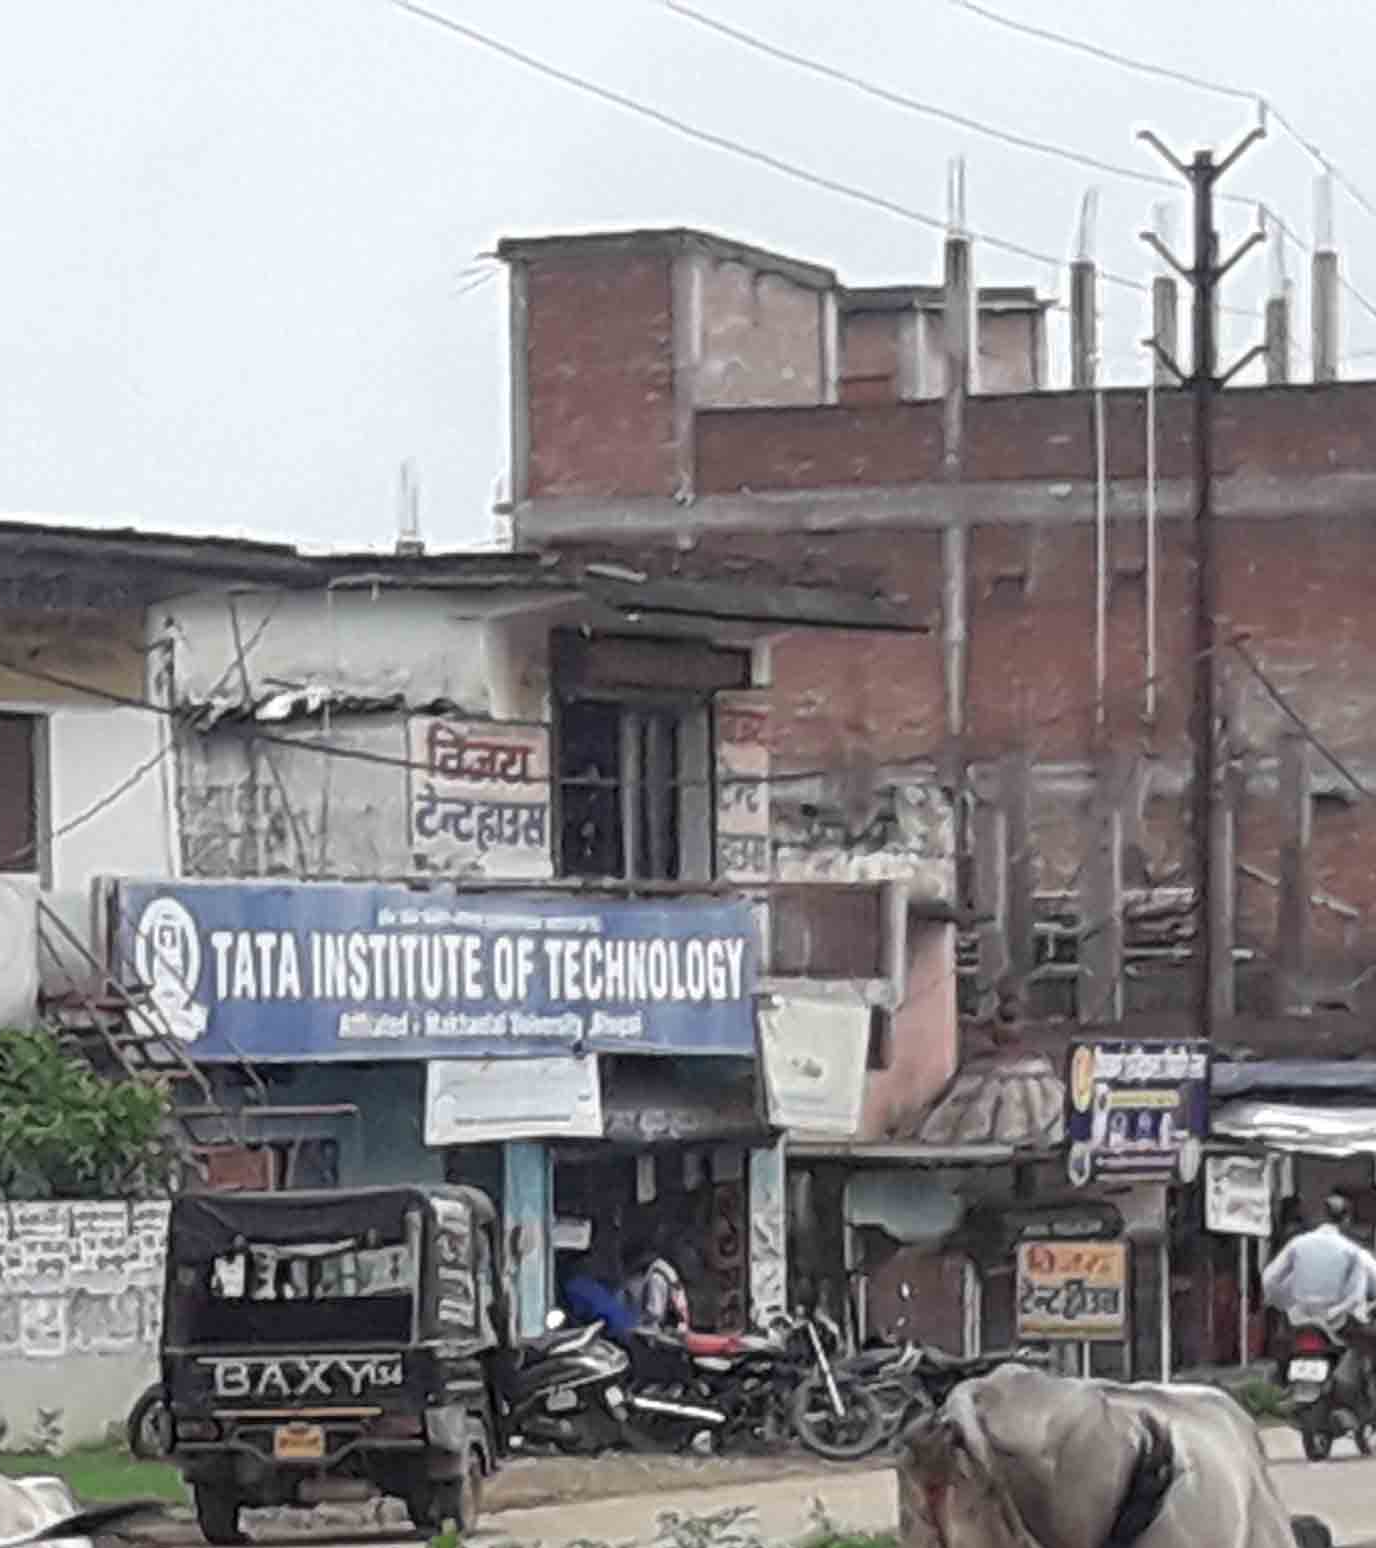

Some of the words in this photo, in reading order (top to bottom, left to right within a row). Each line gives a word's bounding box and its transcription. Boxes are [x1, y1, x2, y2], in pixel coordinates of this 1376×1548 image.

[211, 930, 301, 1000] TATA
[312, 931, 483, 1000] INSTITUTE
[493, 935, 534, 1000] OF
[543, 936, 745, 1001] TECHNOLOGY
[214, 1360, 371, 1396] BAXY
